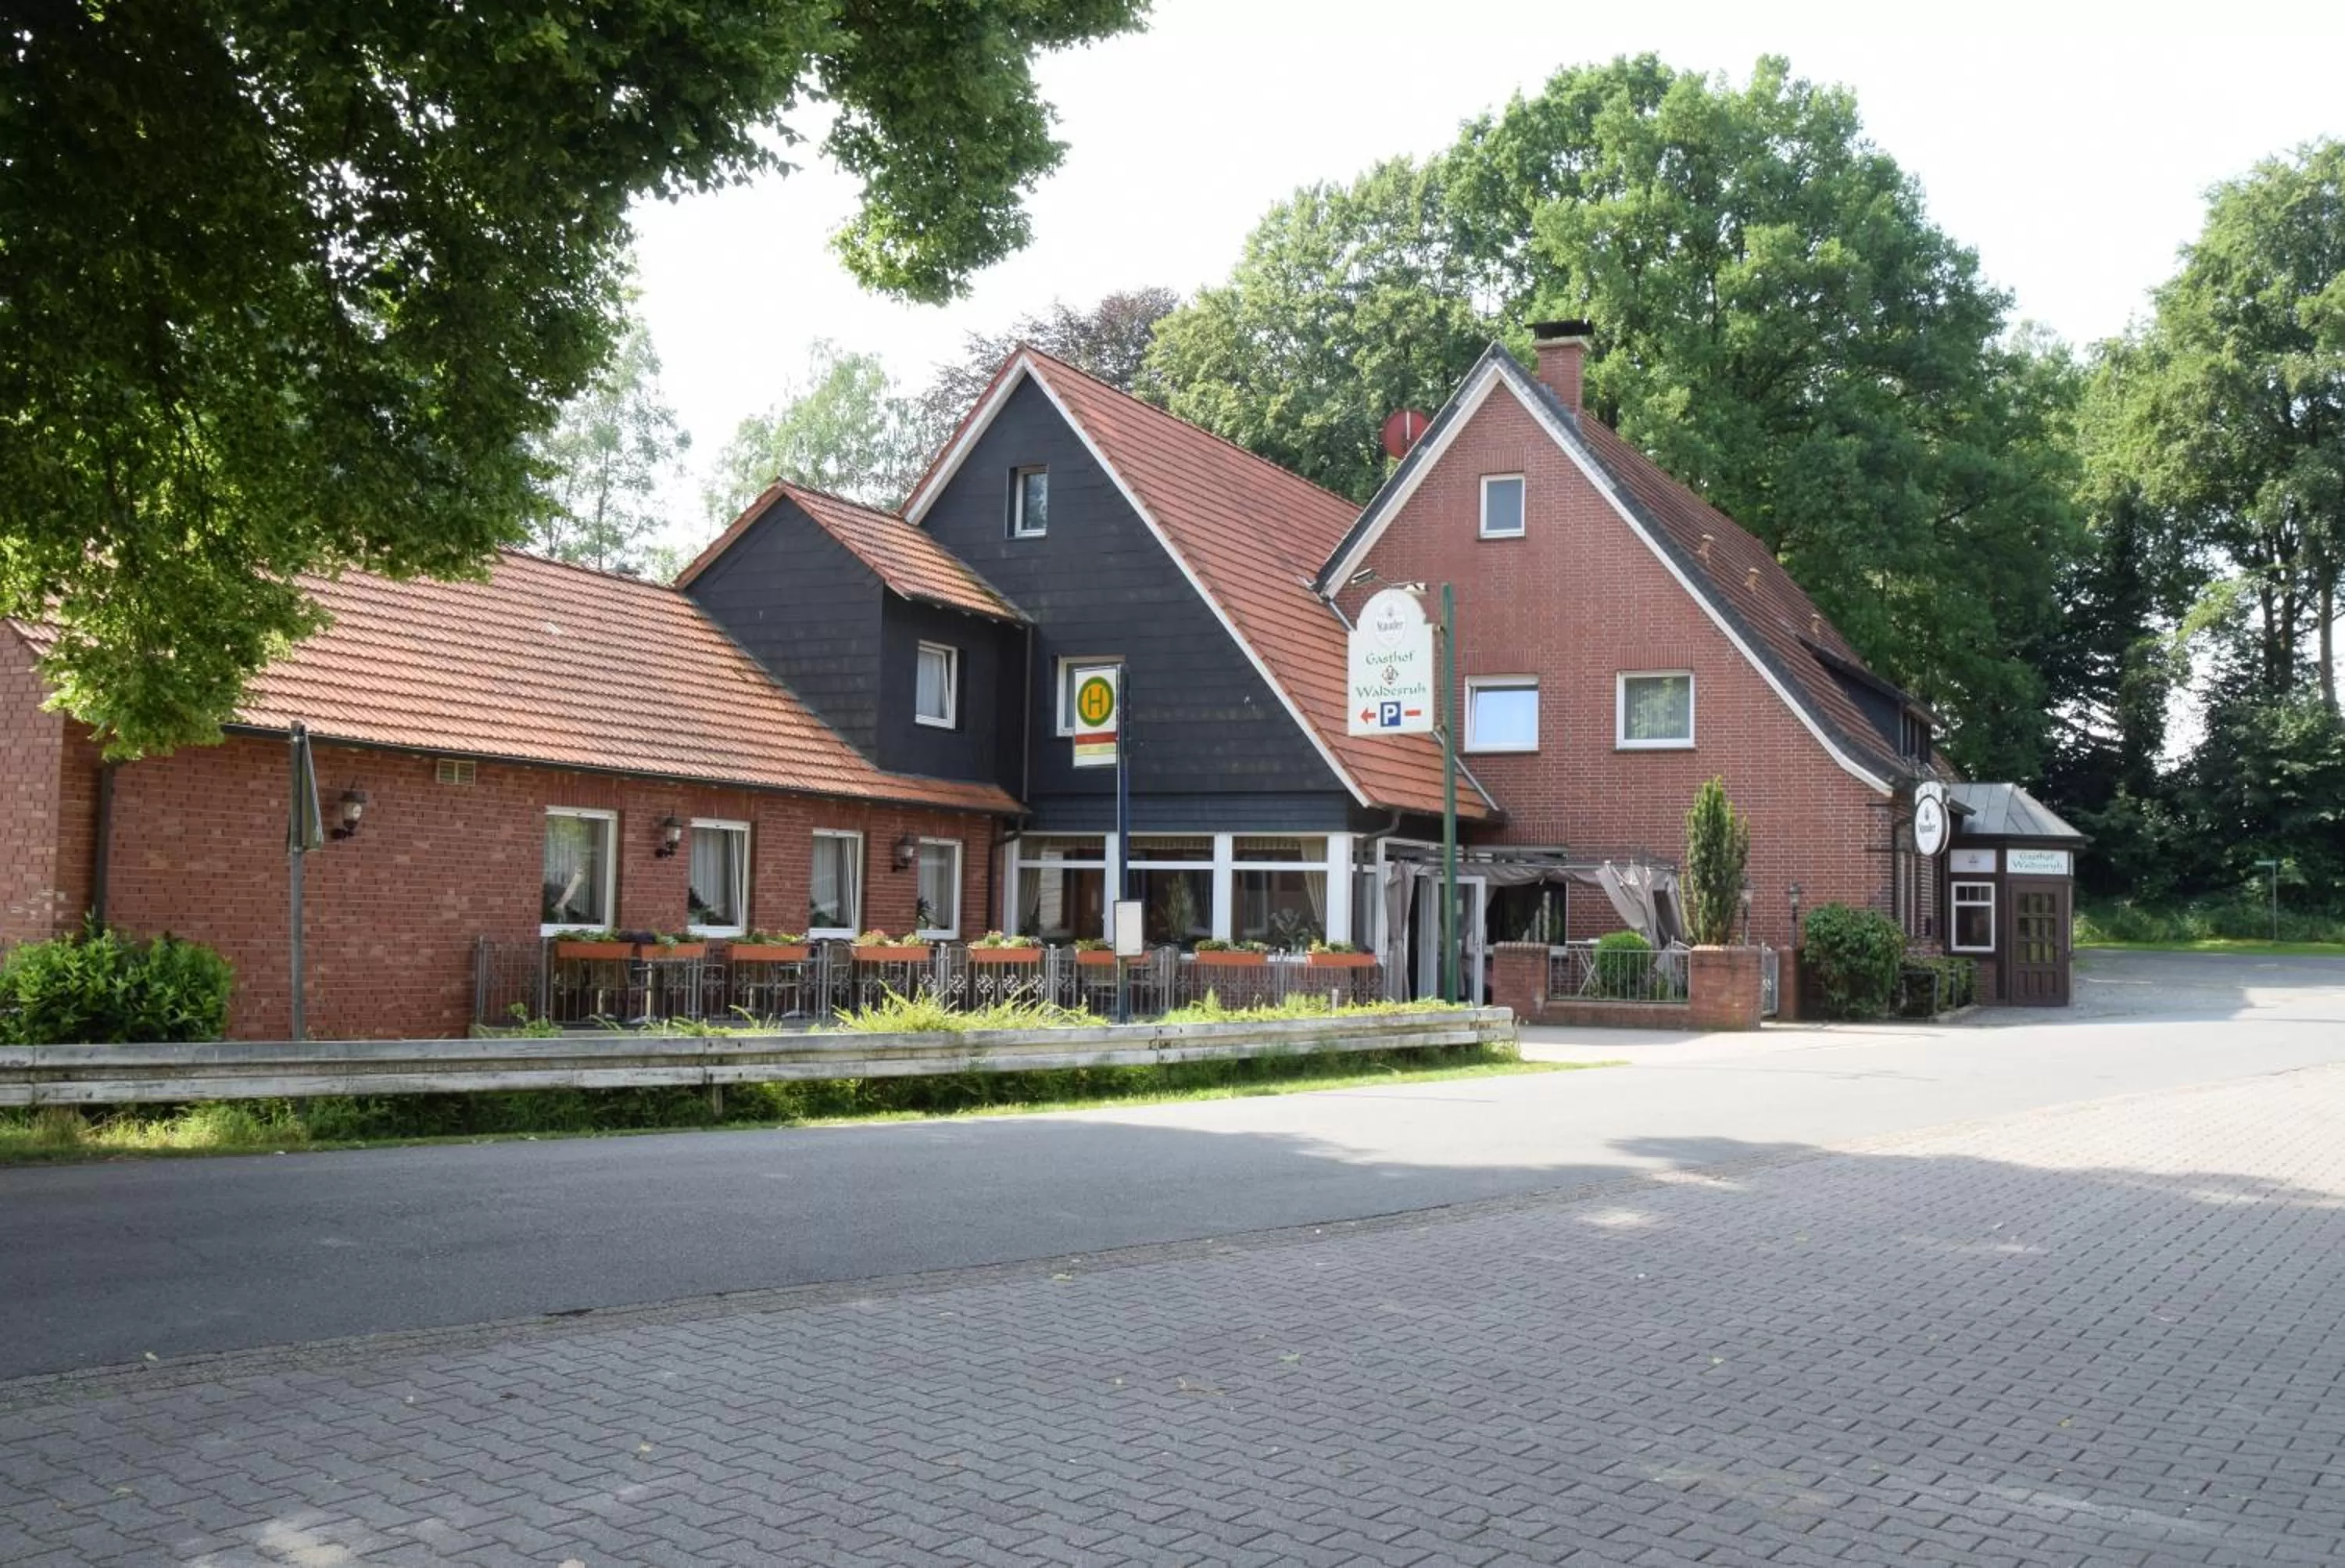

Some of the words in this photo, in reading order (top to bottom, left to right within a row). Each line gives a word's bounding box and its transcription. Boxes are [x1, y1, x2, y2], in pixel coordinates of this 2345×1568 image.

[1366, 650, 1415, 665] Gasthof
[1355, 682, 1427, 698] Waldesruh
[1088, 686, 1103, 715] H
[1382, 703, 1398, 725] P
